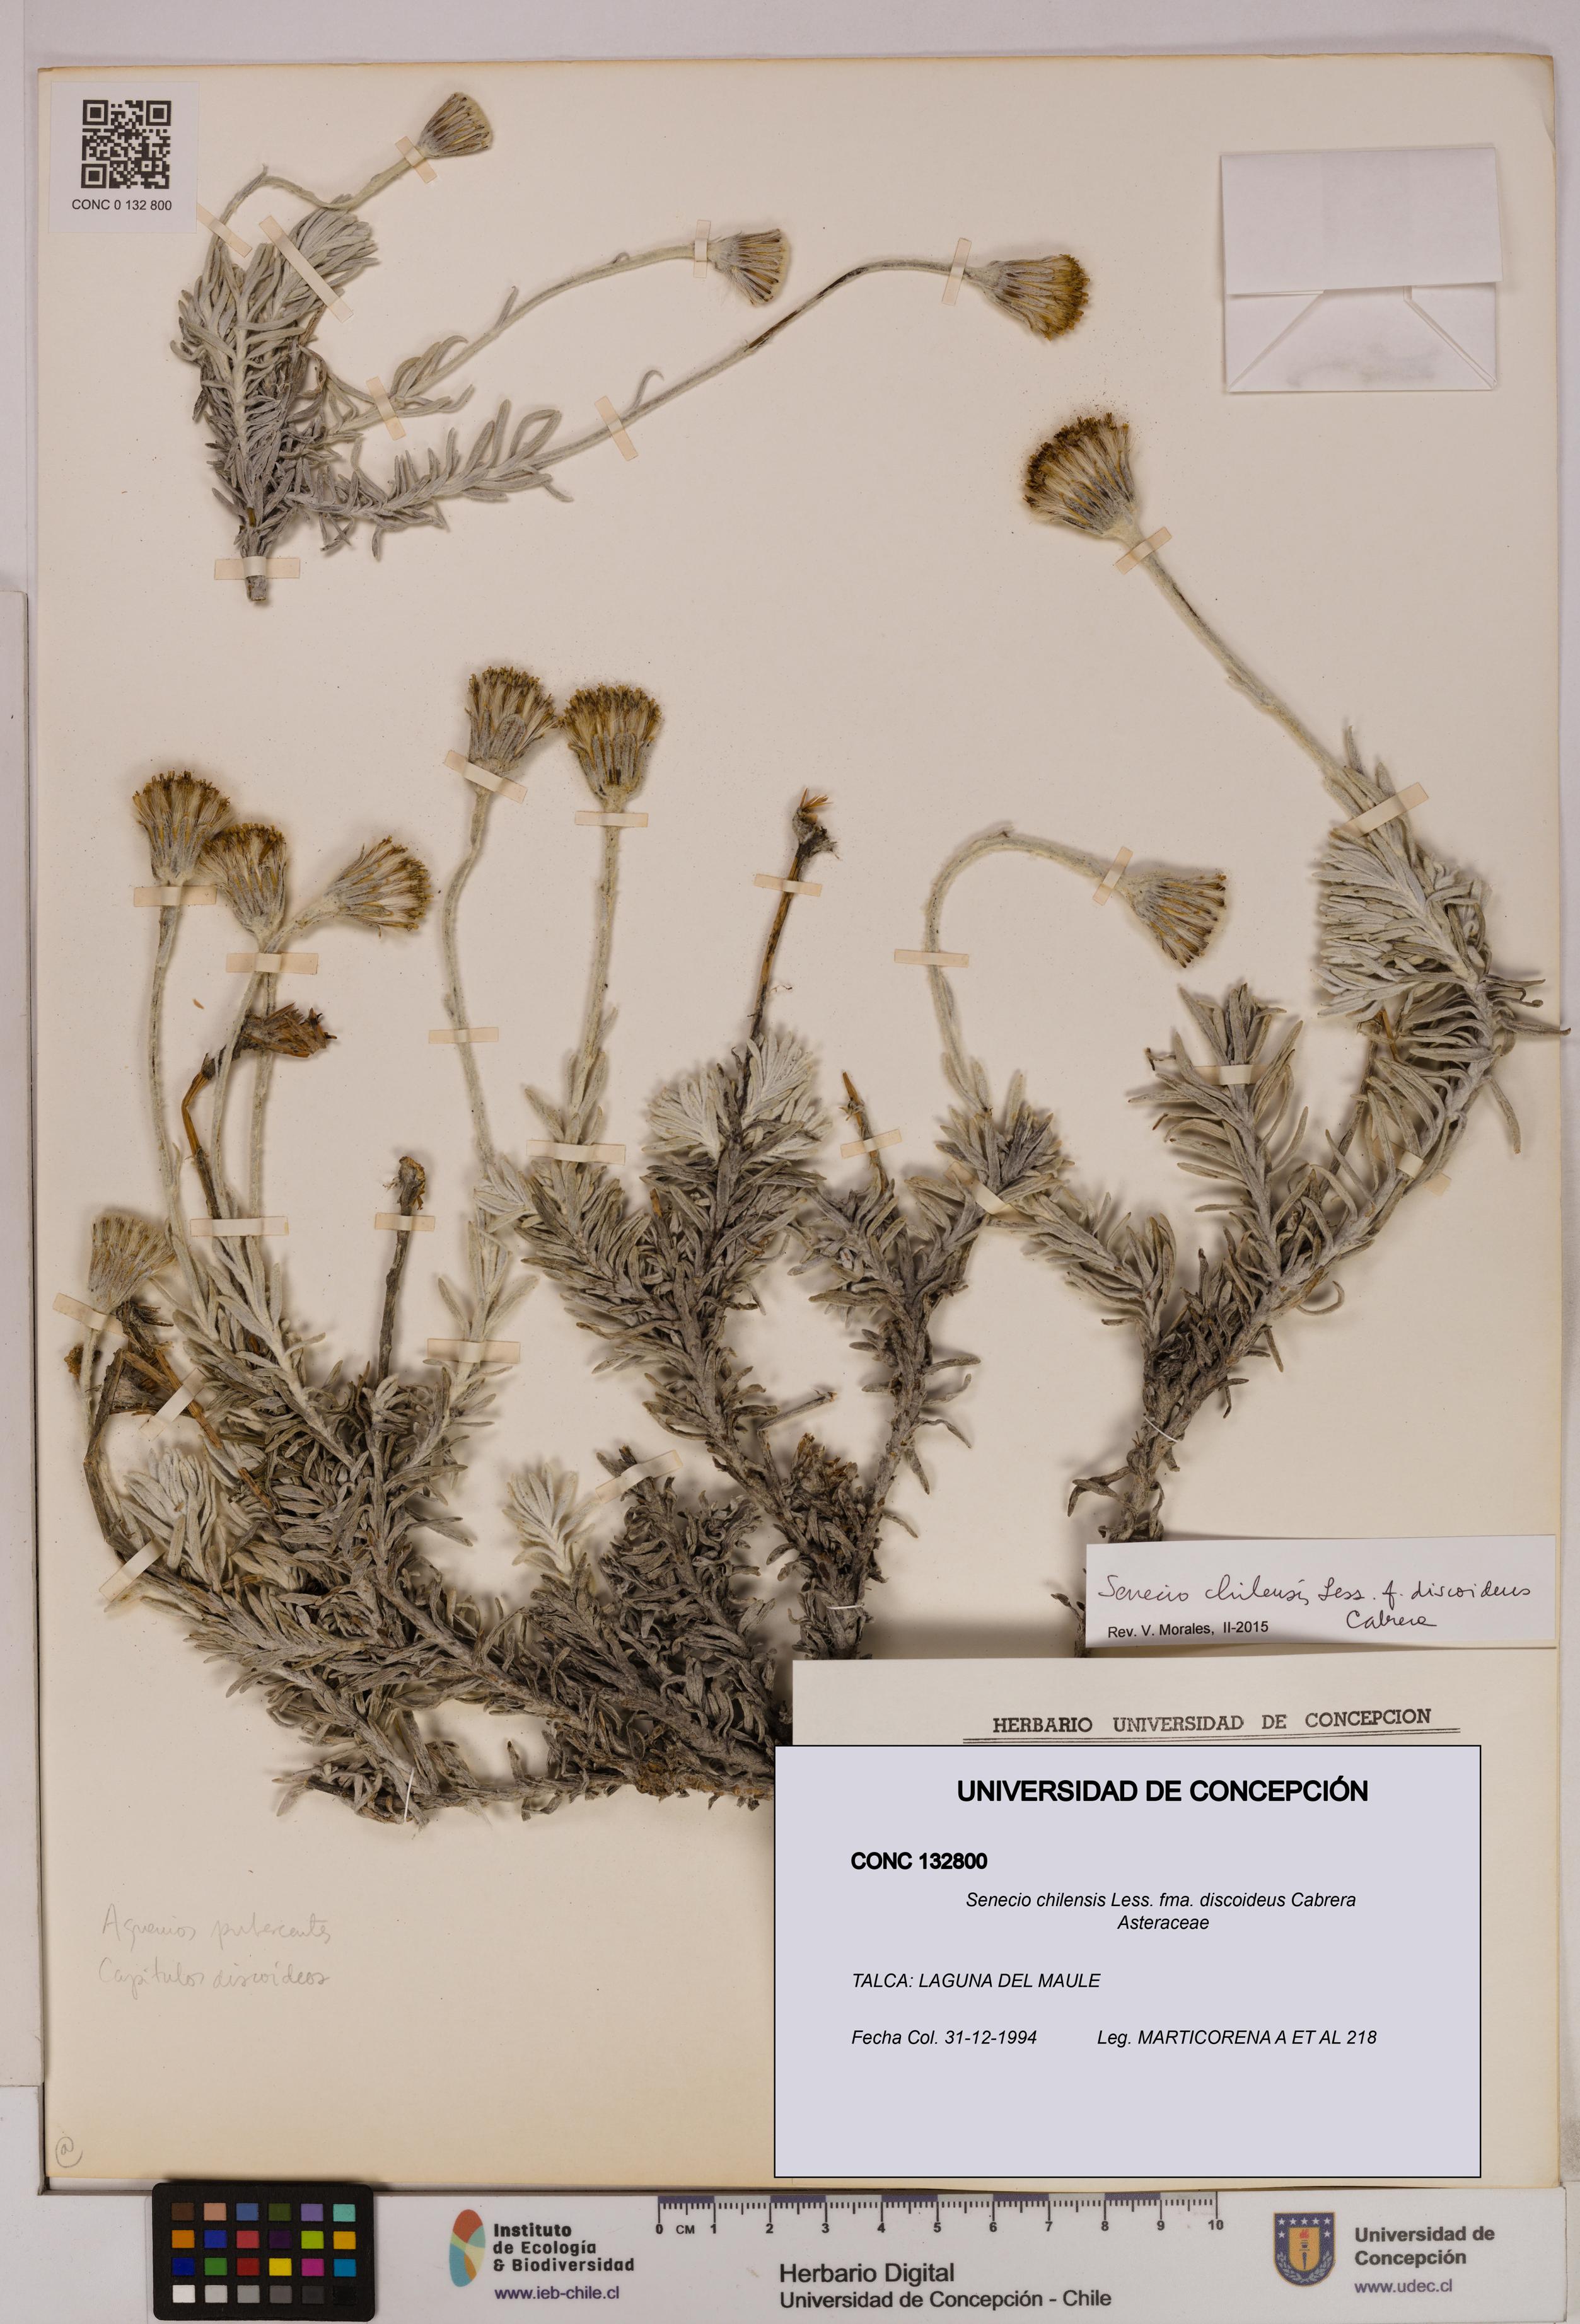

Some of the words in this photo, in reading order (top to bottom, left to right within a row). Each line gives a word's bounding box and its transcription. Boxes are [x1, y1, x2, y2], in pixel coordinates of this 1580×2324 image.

[72, 199, 110, 210] CONC
[114, 200, 121, 210] 0
[126, 200, 146, 210] 132
[151, 200, 171, 211] 800
[1098, 1575, 1188, 1602] Senecio
[1318, 1577, 1376, 1601] Less.
[1381, 1580, 1403, 1610] f.
[1411, 1580, 1530, 1600] discoideus
[1347, 1610, 1437, 1629] Cabrera
[1108, 1626, 1137, 1638] Rev.
[1141, 1624, 1155, 1636] V.
[1159, 1623, 1215, 1637] Morales,
[1223, 1621, 1269, 1634] II-2015
[993, 1717, 1093, 1733] HERBARIO
[1113, 1715, 1244, 1732] UNIVERSIDAD
[1262, 1714, 1287, 1729] DE
[1305, 1709, 1431, 1728] CONCEPCION
[494, 2223, 572, 2237] Instituto
[656, 2223, 663, 2234] 0
[676, 2225, 695, 2234] CM
[711, 2223, 716, 2234] 1
[766, 2223, 774, 2234] 2
[822, 2223, 830, 2233] 3
[877, 2222, 885, 2233] 4
[933, 2221, 941, 2233] 5
[989, 2221, 997, 2232] 6
[1045, 2221, 1053, 2231] 7
[1101, 2221, 1109, 2231] 8
[1157, 2221, 1165, 2231] 9
[1208, 2219, 1224, 2230] 10
[1356, 2226, 1466, 2242] Universidad
[1472, 2226, 1495, 2241] de
[493, 2241, 514, 2254] de
[521, 2240, 596, 2257] Ecología
[494, 2258, 505, 2272] &
[513, 2257, 634, 2272] Biodiversidad
[1354, 2249, 1467, 2269] Concepción
[781, 2263, 877, 2282] Herbario
[885, 2263, 954, 2287] Digital
[494, 2286, 619, 2299] www.ieb-chile.cl
[1354, 2279, 1452, 2293] www.udec.cl
[781, 2291, 893, 2308] Universidad
[899, 2291, 923, 2308] de
[929, 2290, 1043, 2311] Concepción
[1063, 2289, 1112, 2306] Chile
